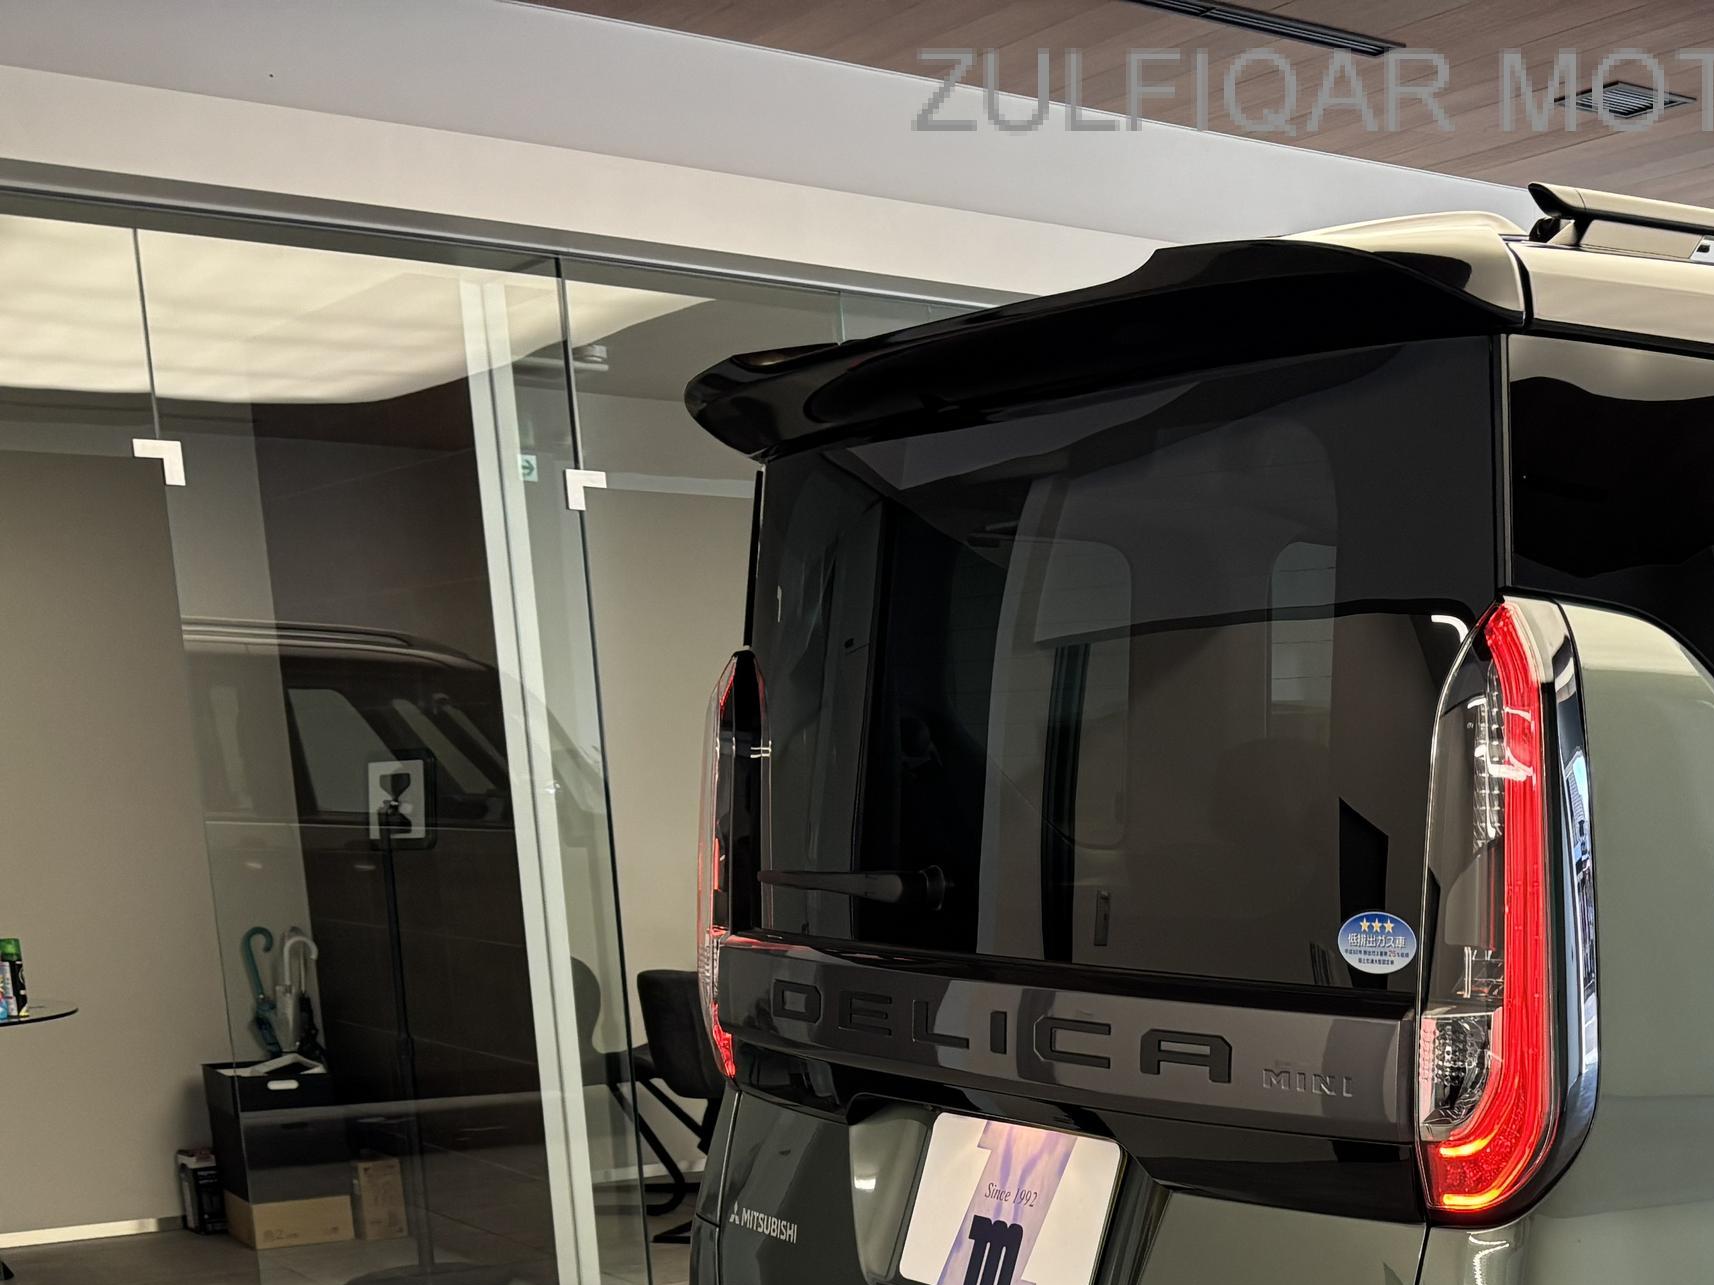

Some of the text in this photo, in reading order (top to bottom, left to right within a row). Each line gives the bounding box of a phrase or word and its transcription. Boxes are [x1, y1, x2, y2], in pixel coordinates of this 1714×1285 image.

[771, 977, 1353, 1098] DELICA MINI
[984, 1182, 1039, 1208] Since 1992
[741, 1207, 798, 1244] MITSUBISHI
